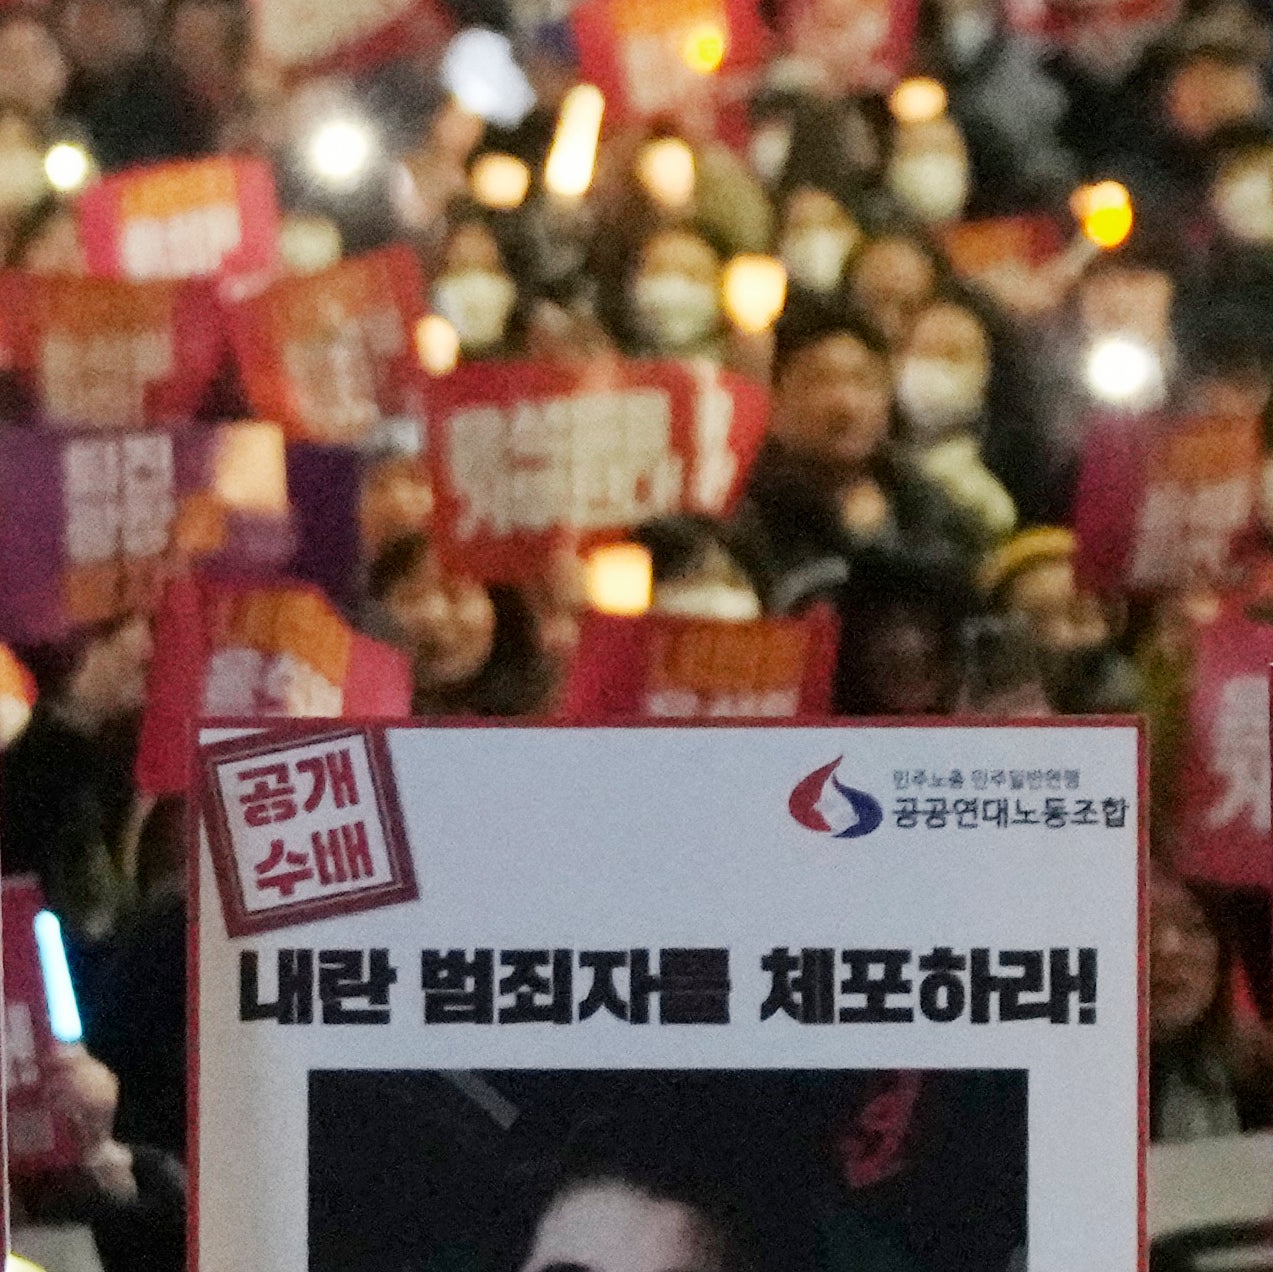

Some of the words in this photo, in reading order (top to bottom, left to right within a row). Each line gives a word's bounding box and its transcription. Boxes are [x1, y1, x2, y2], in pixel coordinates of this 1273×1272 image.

[236, 748, 360, 828] 공개
[892, 796, 1130, 829] 공공연대노동조합
[254, 821, 374, 897] 수배
[239, 947, 398, 1025] 내란
[421, 947, 731, 1025] 범죄자를
[759, 946, 1098, 1025] 체포하라!
